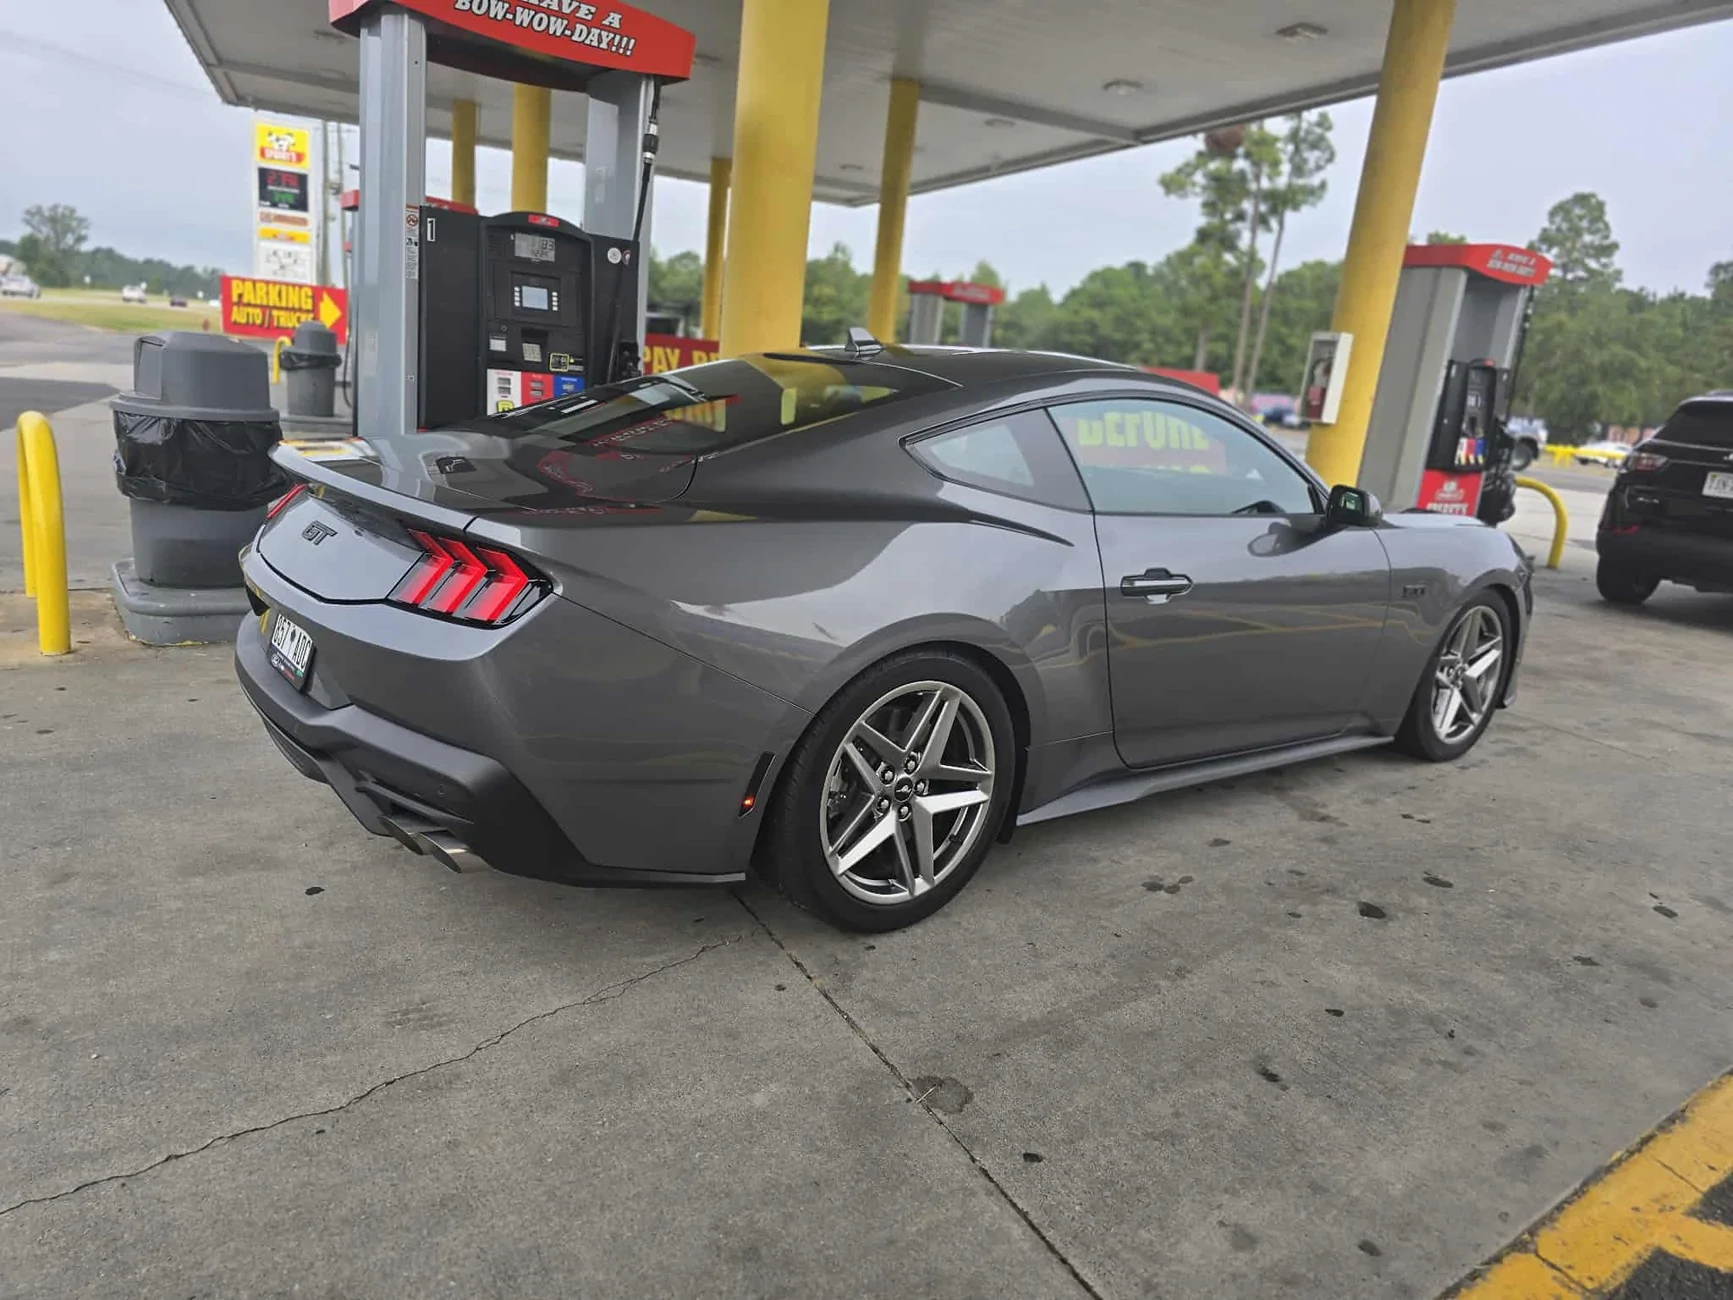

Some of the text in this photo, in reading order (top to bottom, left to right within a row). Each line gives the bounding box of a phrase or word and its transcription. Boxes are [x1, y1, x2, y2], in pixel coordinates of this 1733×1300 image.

[602, 11, 622, 28] A
[428, 219, 434, 241] 1
[231, 279, 314, 311] PARKING
[231, 306, 263, 325] AUTO
[643, 345, 680, 374] PAY
[302, 520, 338, 546] GT
